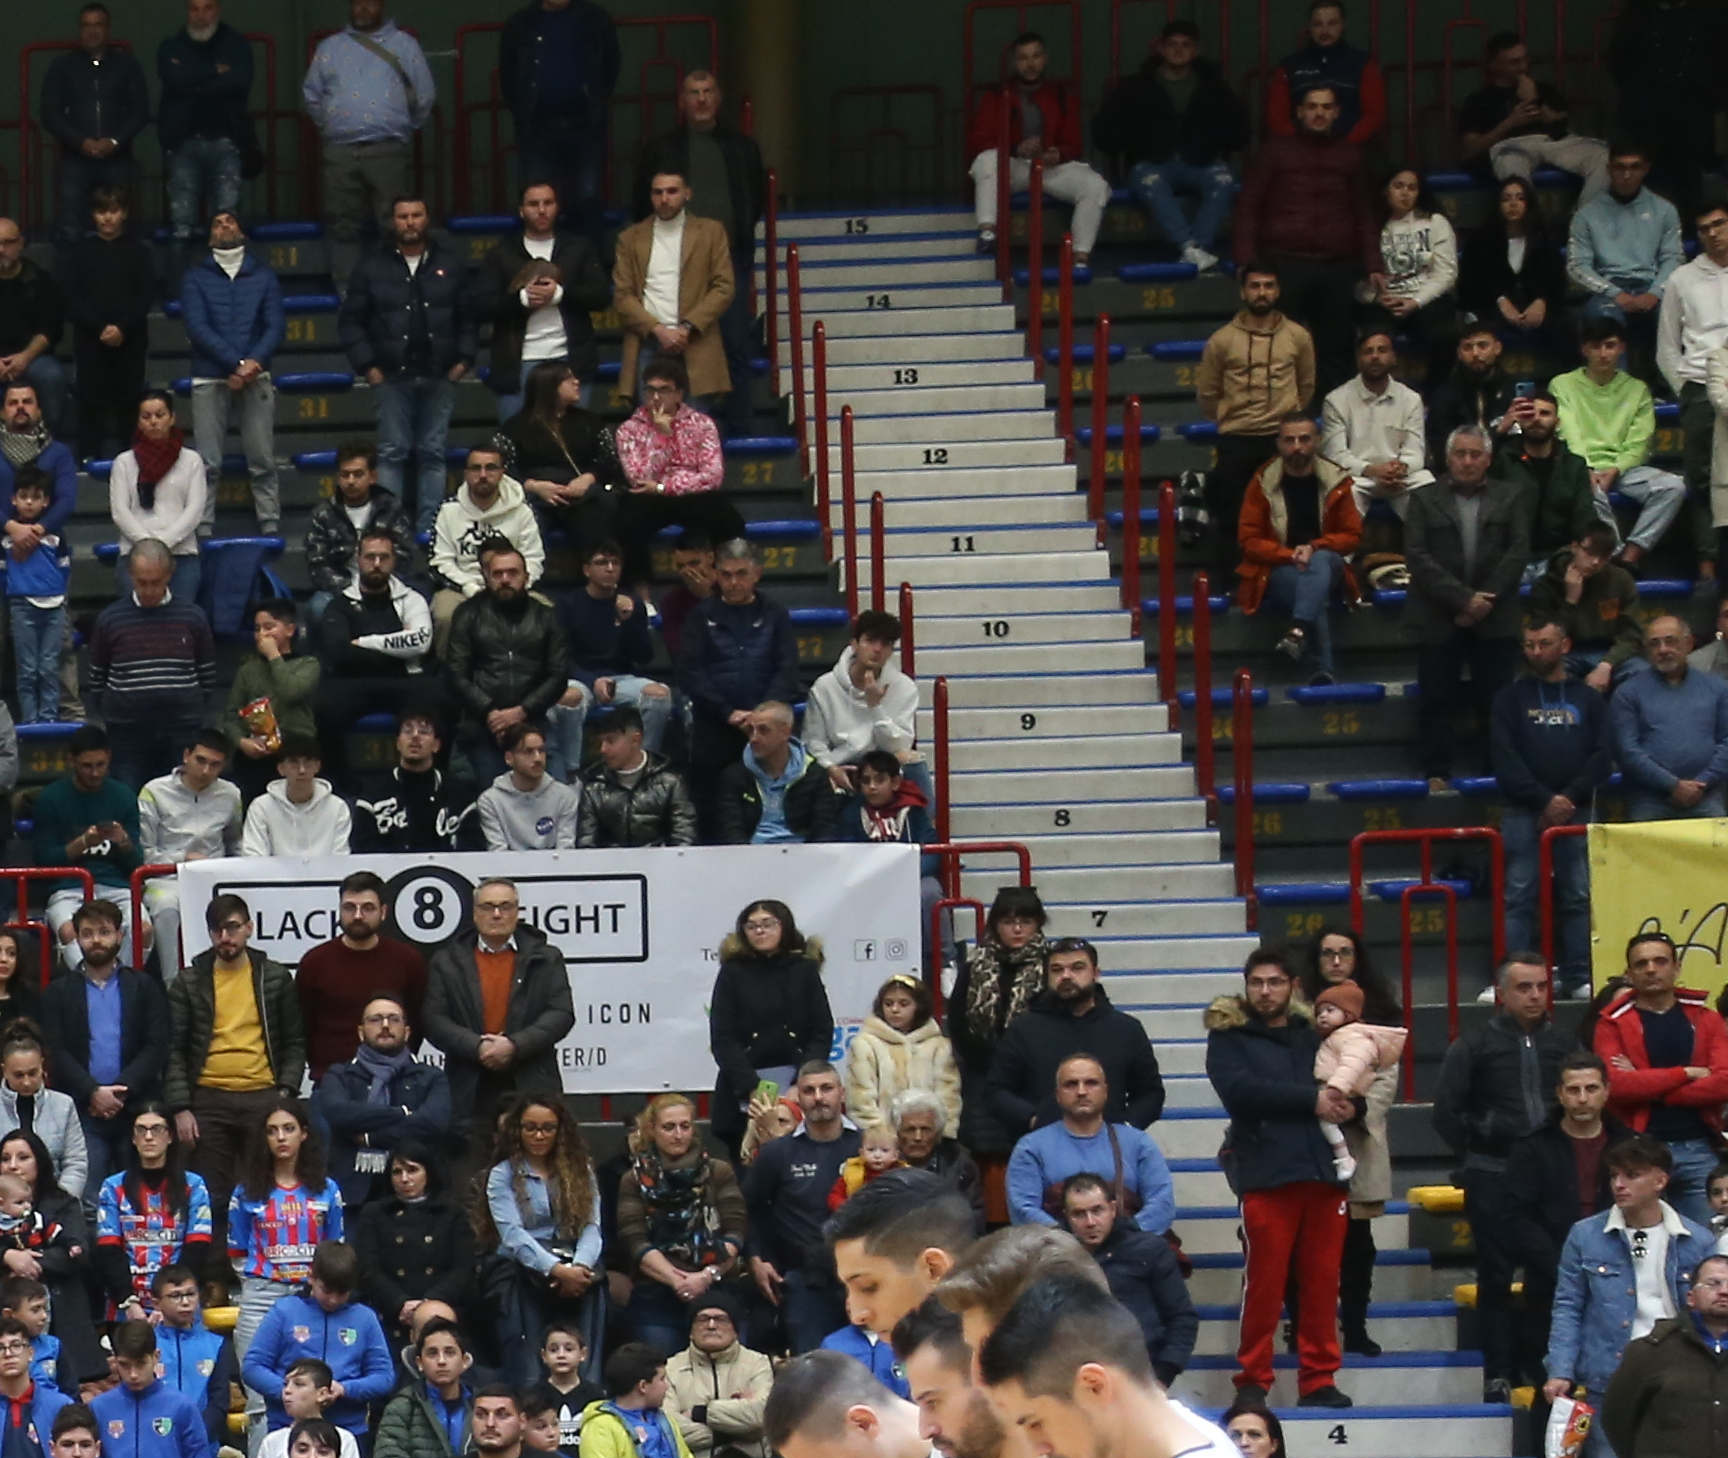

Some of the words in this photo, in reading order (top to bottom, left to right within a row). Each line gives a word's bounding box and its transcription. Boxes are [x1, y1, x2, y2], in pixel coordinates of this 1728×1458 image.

[845, 219, 868, 234] 15
[866, 294, 891, 311] 14
[893, 368, 919, 385] 13
[921, 448, 948, 465] 12
[949, 536, 976, 553] 11
[981, 620, 1010, 637] 10
[1020, 712, 1036, 730] 9
[1054, 810, 1071, 827] 8
[256, 909, 343, 941] LACK
[413, 886, 445, 930] 8
[1092, 911, 1108, 928] 7
[588, 1003, 651, 1025] ICON
[1327, 1424, 1348, 1445] 4
